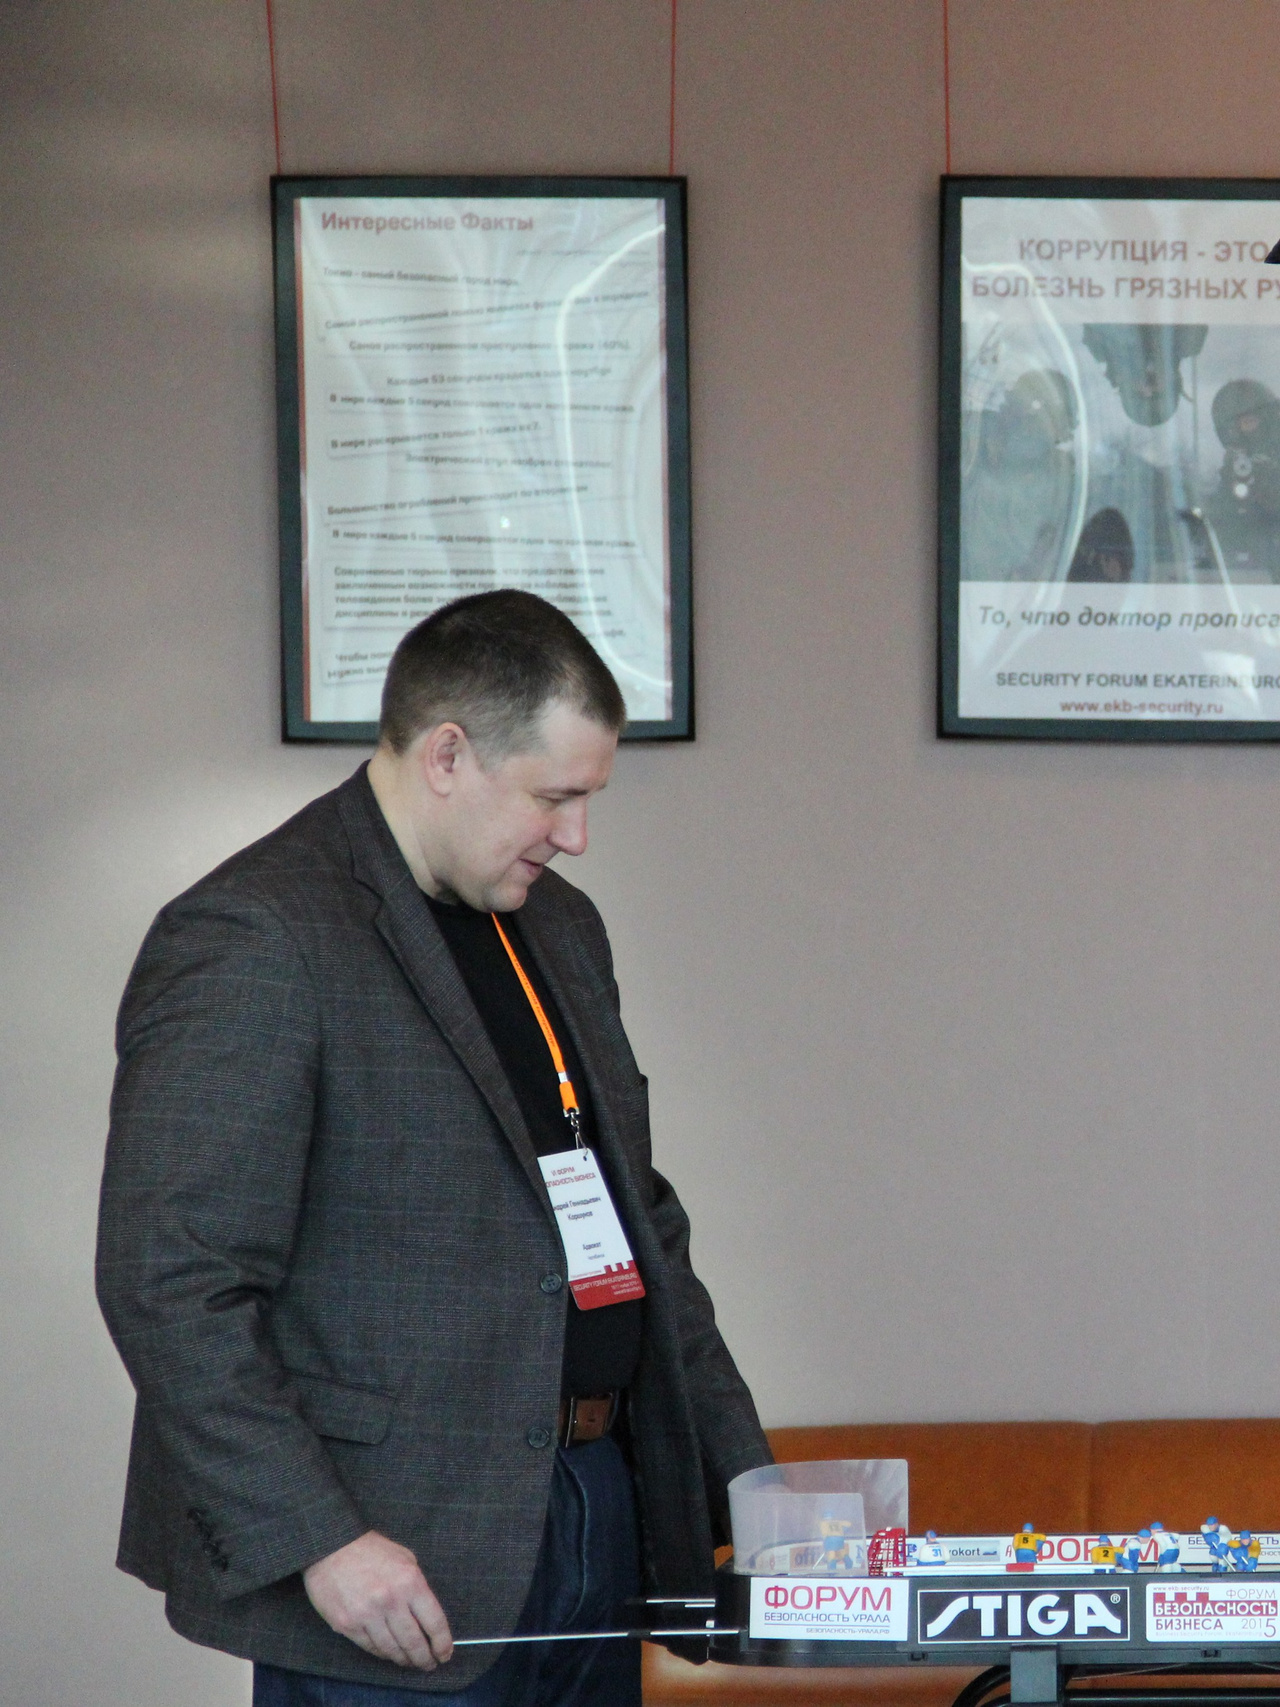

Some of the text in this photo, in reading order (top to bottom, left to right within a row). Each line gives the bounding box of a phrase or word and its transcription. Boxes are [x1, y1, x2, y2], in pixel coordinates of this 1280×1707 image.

[321, 212, 534, 234] Интересные Факты
[1019, 239, 1187, 265] КОРРУПЦИЯ
[1214, 241, 1270, 262] ЭТО
[972, 275, 1104, 298] БОЛЕЗНЬ
[1114, 276, 1248, 299] ГРЯЗНЫХ
[978, 606, 1011, 629] То,
[1021, 608, 1070, 626] что
[1078, 606, 1171, 632] доктор
[996, 672, 1081, 688] SECURITY
[1086, 673, 1148, 688] FORUM
[1059, 698, 1224, 716] www.ekb-security.ru
[545, 1177, 574, 1188] ОПАСНОСТЬ
[552, 1202, 569, 1211] ндрей
[948, 1547, 980, 1556] okort
[1102, 1549, 1109, 1558] 2
[764, 1585, 891, 1611] ФОРУМ
[1226, 1588, 1276, 1599] ФОРУМ
[927, 1594, 1122, 1637] STIGA
[1155, 1602, 1277, 1615] БЕЗОПАСНОСТЬ
[764, 1612, 890, 1623] БЕЗОПАСНОСТЬ УРАЛА
[1156, 1618, 1223, 1630] БИЗНЕСА
